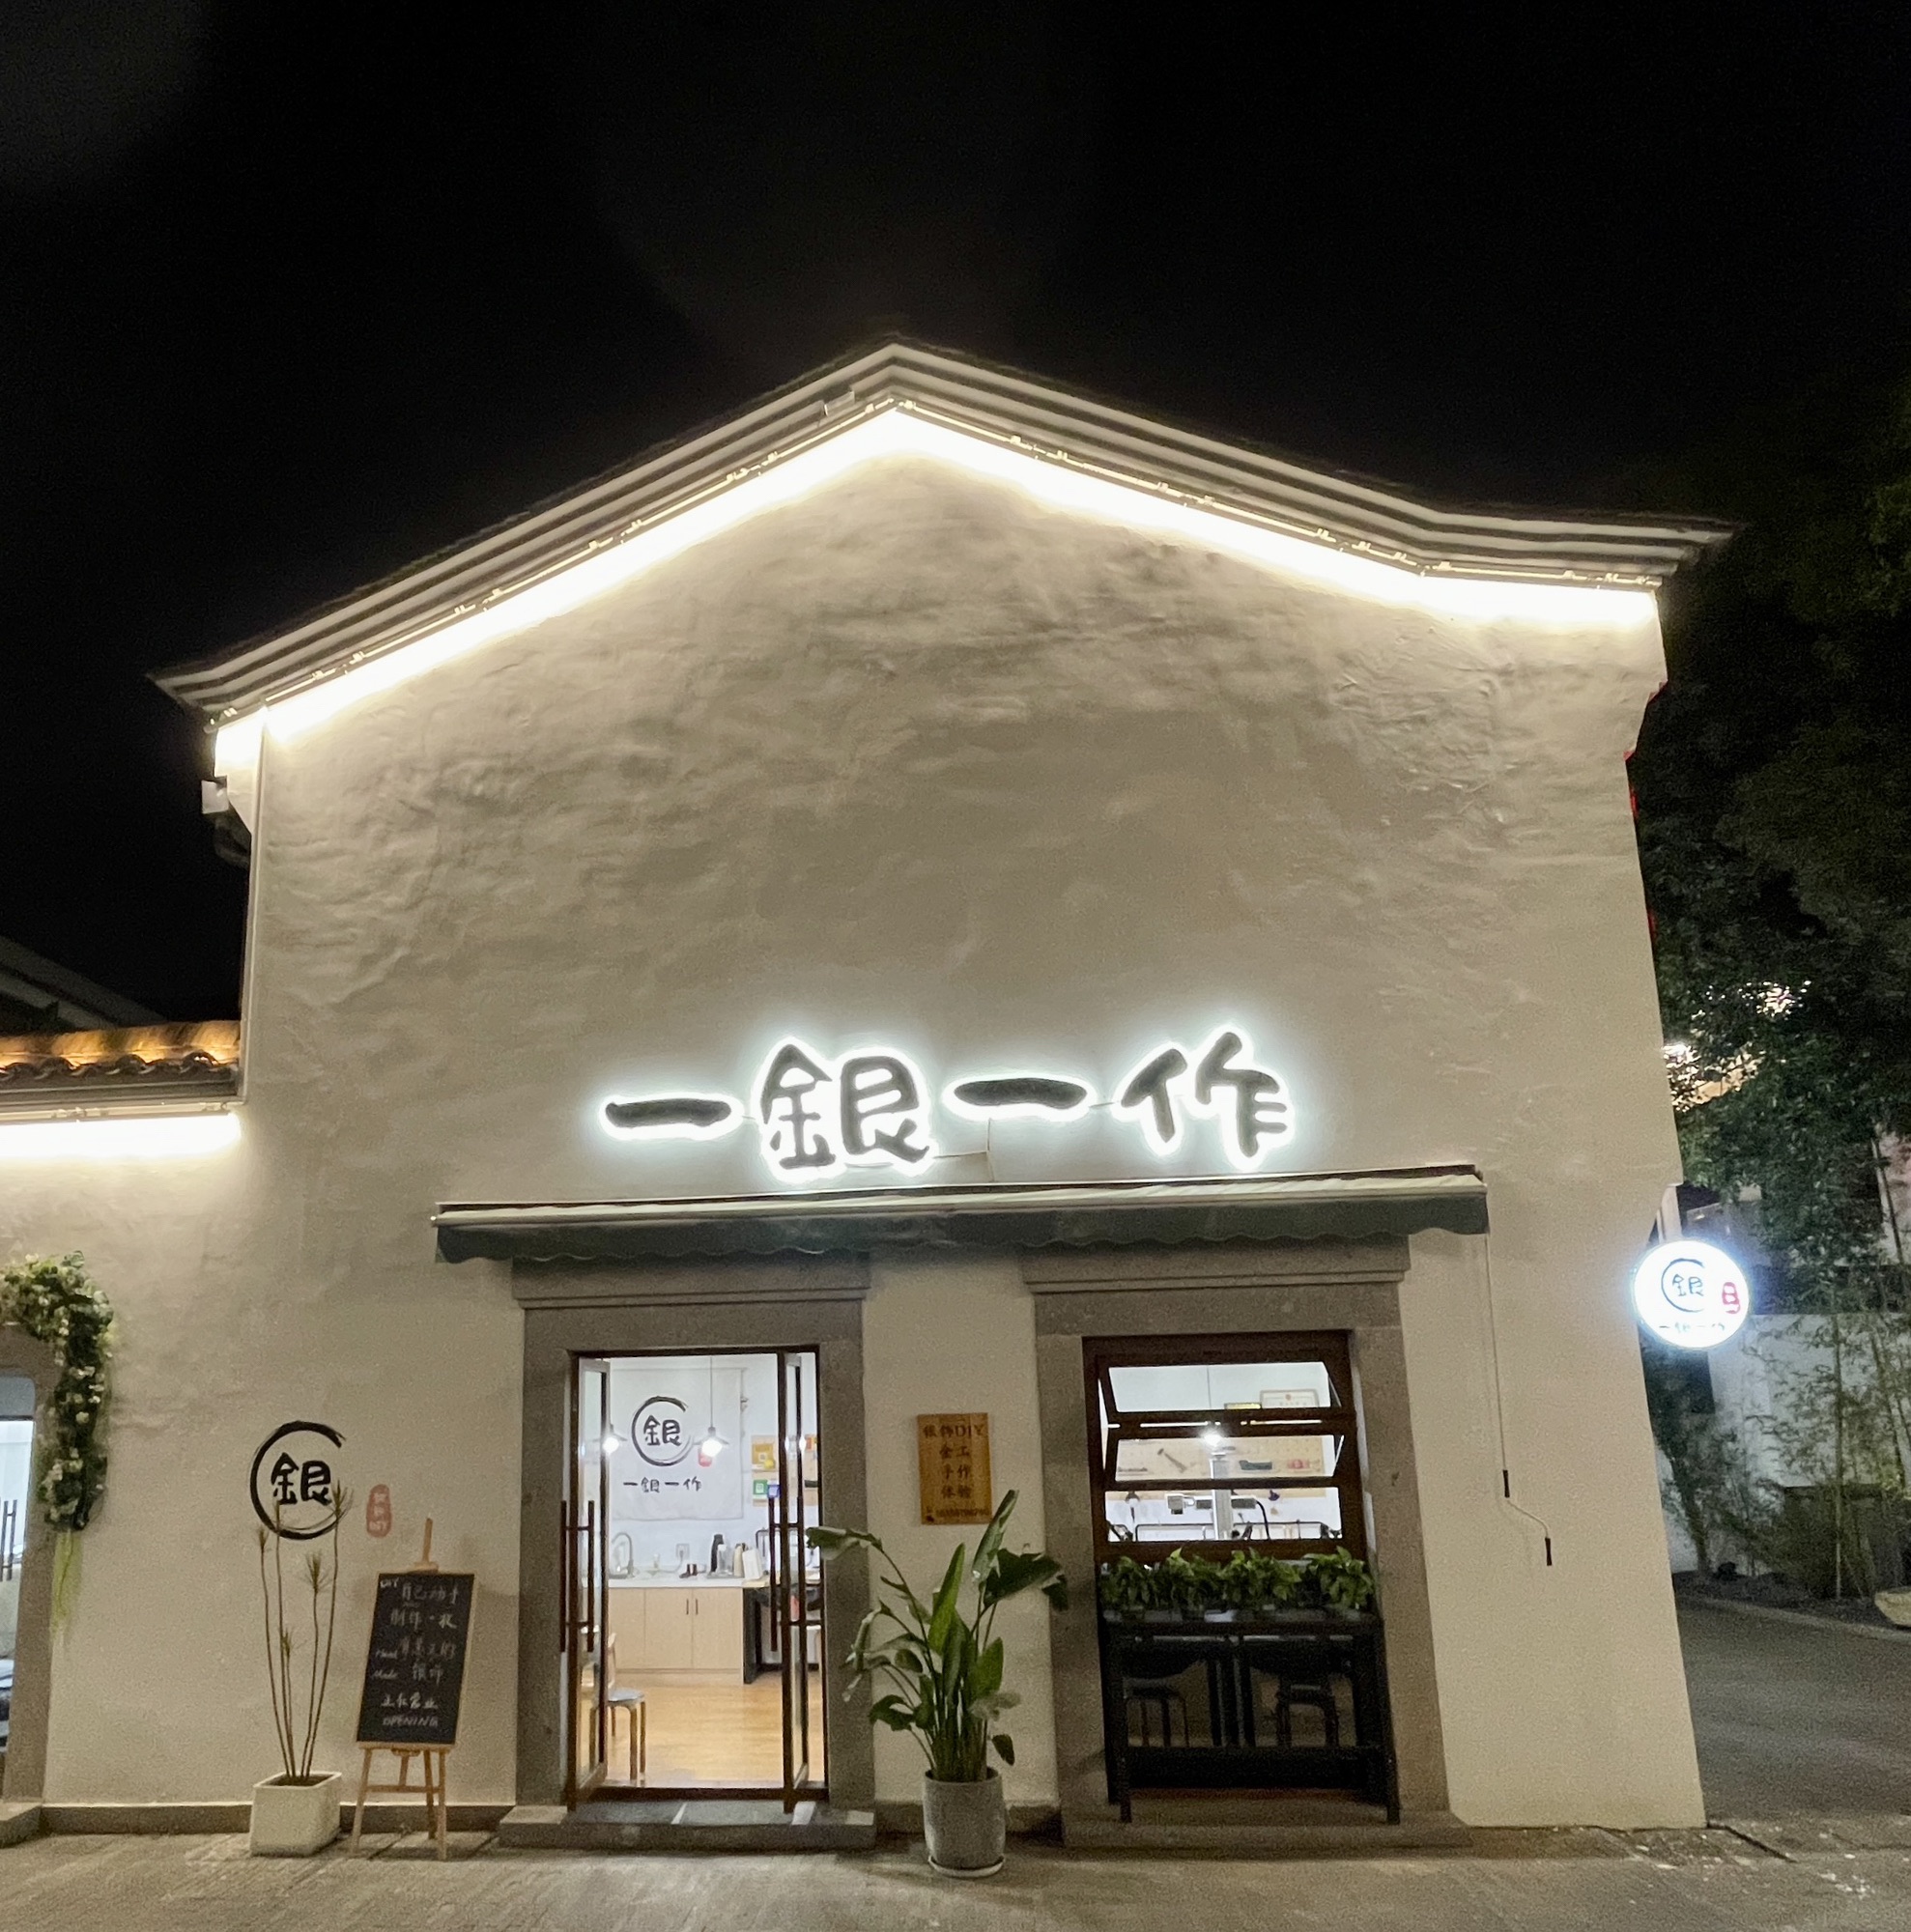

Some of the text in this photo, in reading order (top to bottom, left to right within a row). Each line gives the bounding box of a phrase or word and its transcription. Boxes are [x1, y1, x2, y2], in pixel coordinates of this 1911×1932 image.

[605, 1032, 1288, 1169] 一銀一作
[642, 1414, 682, 1446] 銀
[271, 1452, 332, 1506] 銀
[623, 1476, 702, 1492] 一銀一作
